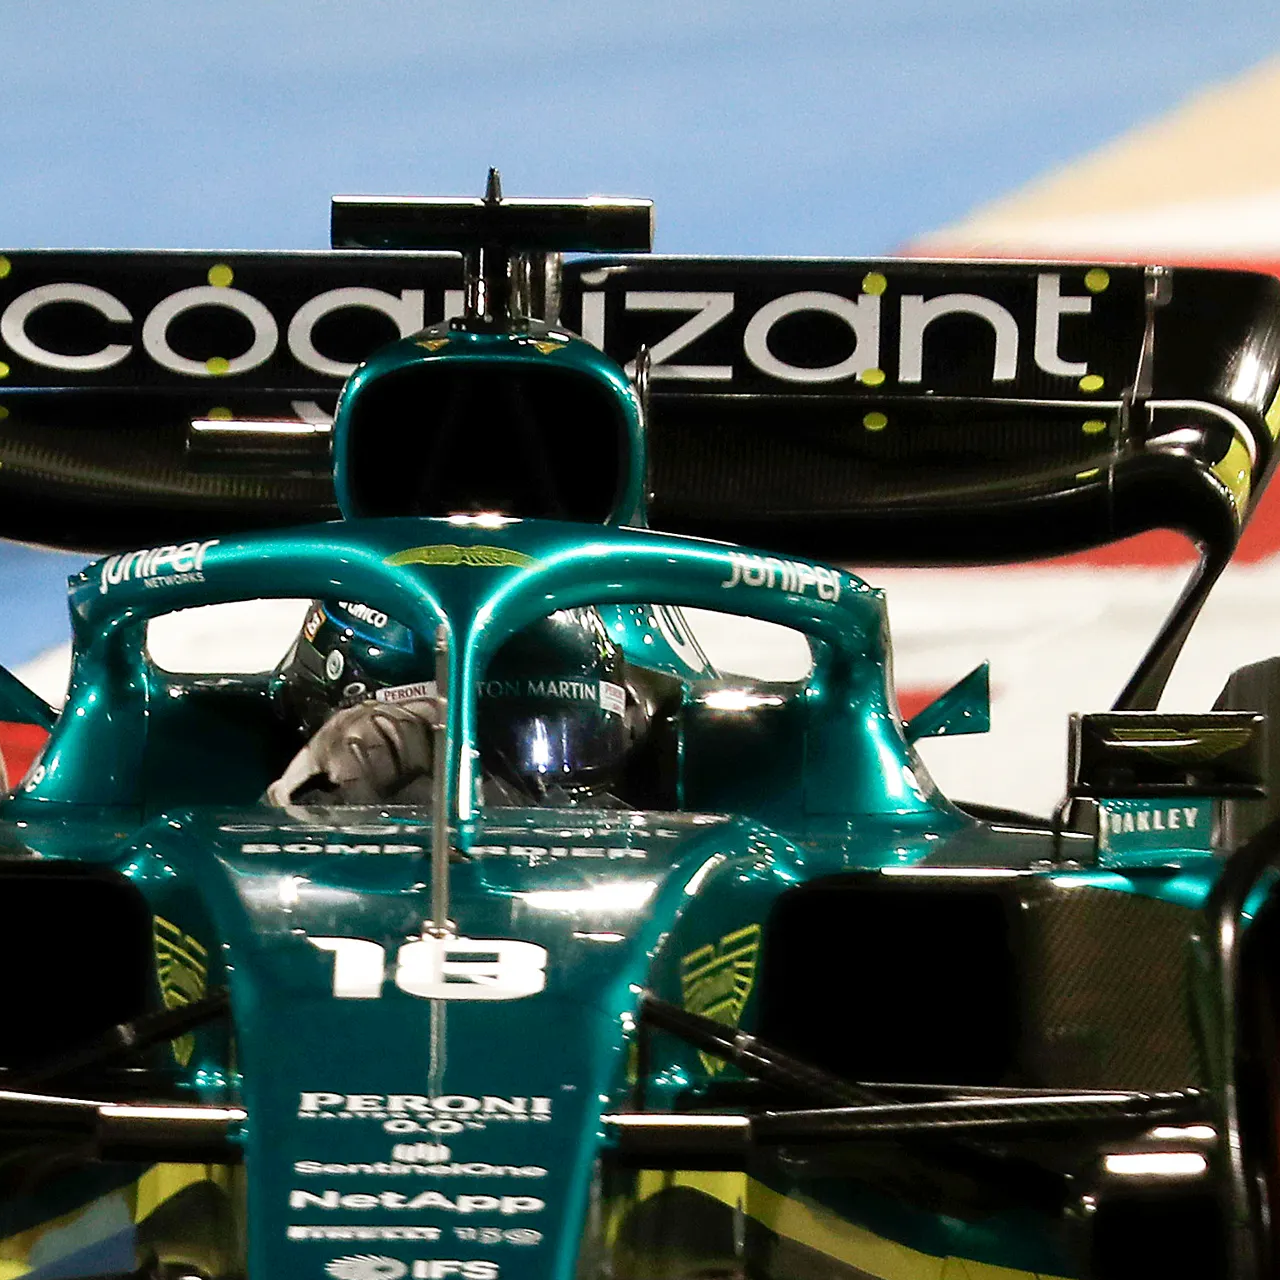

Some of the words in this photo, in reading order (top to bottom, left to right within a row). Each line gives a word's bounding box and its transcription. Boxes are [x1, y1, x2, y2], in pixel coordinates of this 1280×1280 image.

[0, 267, 1094, 426] cogizant
[143, 571, 206, 590] NETWORKS
[383, 686, 427, 702] PERONI
[527, 680, 597, 701] MARTIN
[1109, 807, 1198, 834] OAKLEY
[241, 842, 647, 860] BOMBRDIER
[307, 935, 548, 999] 18
[298, 1092, 552, 1114] PERONI
[289, 1189, 546, 1214] NetApp
